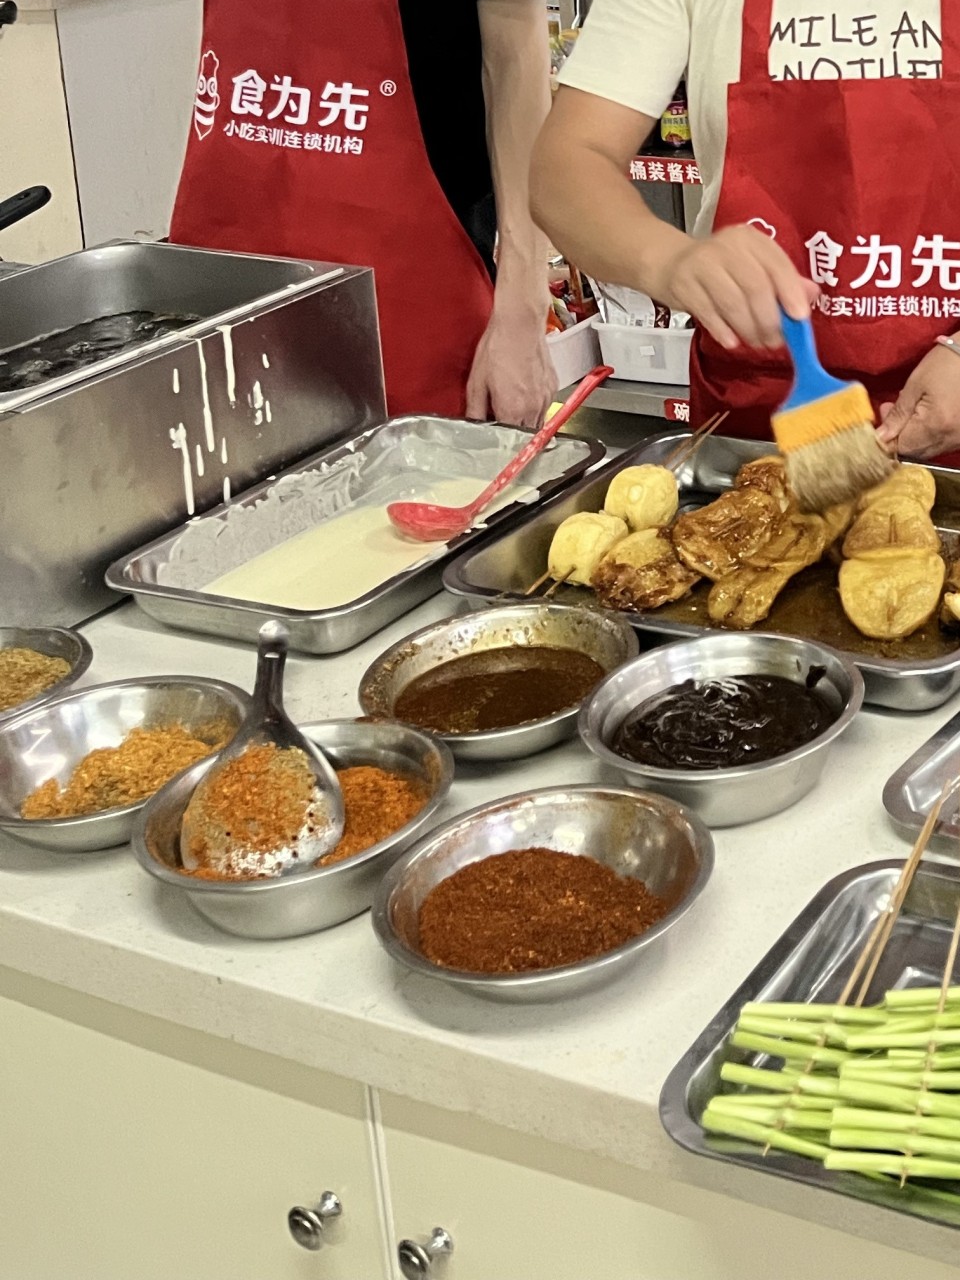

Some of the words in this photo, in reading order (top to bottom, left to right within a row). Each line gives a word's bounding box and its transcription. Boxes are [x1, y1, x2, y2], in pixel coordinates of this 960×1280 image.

[769, 14, 878, 48] MILE
[230, 69, 369, 131] 食为先
[223, 119, 364, 155] 小吃实训连锁机构
[629, 160, 703, 184] 桶装酱料
